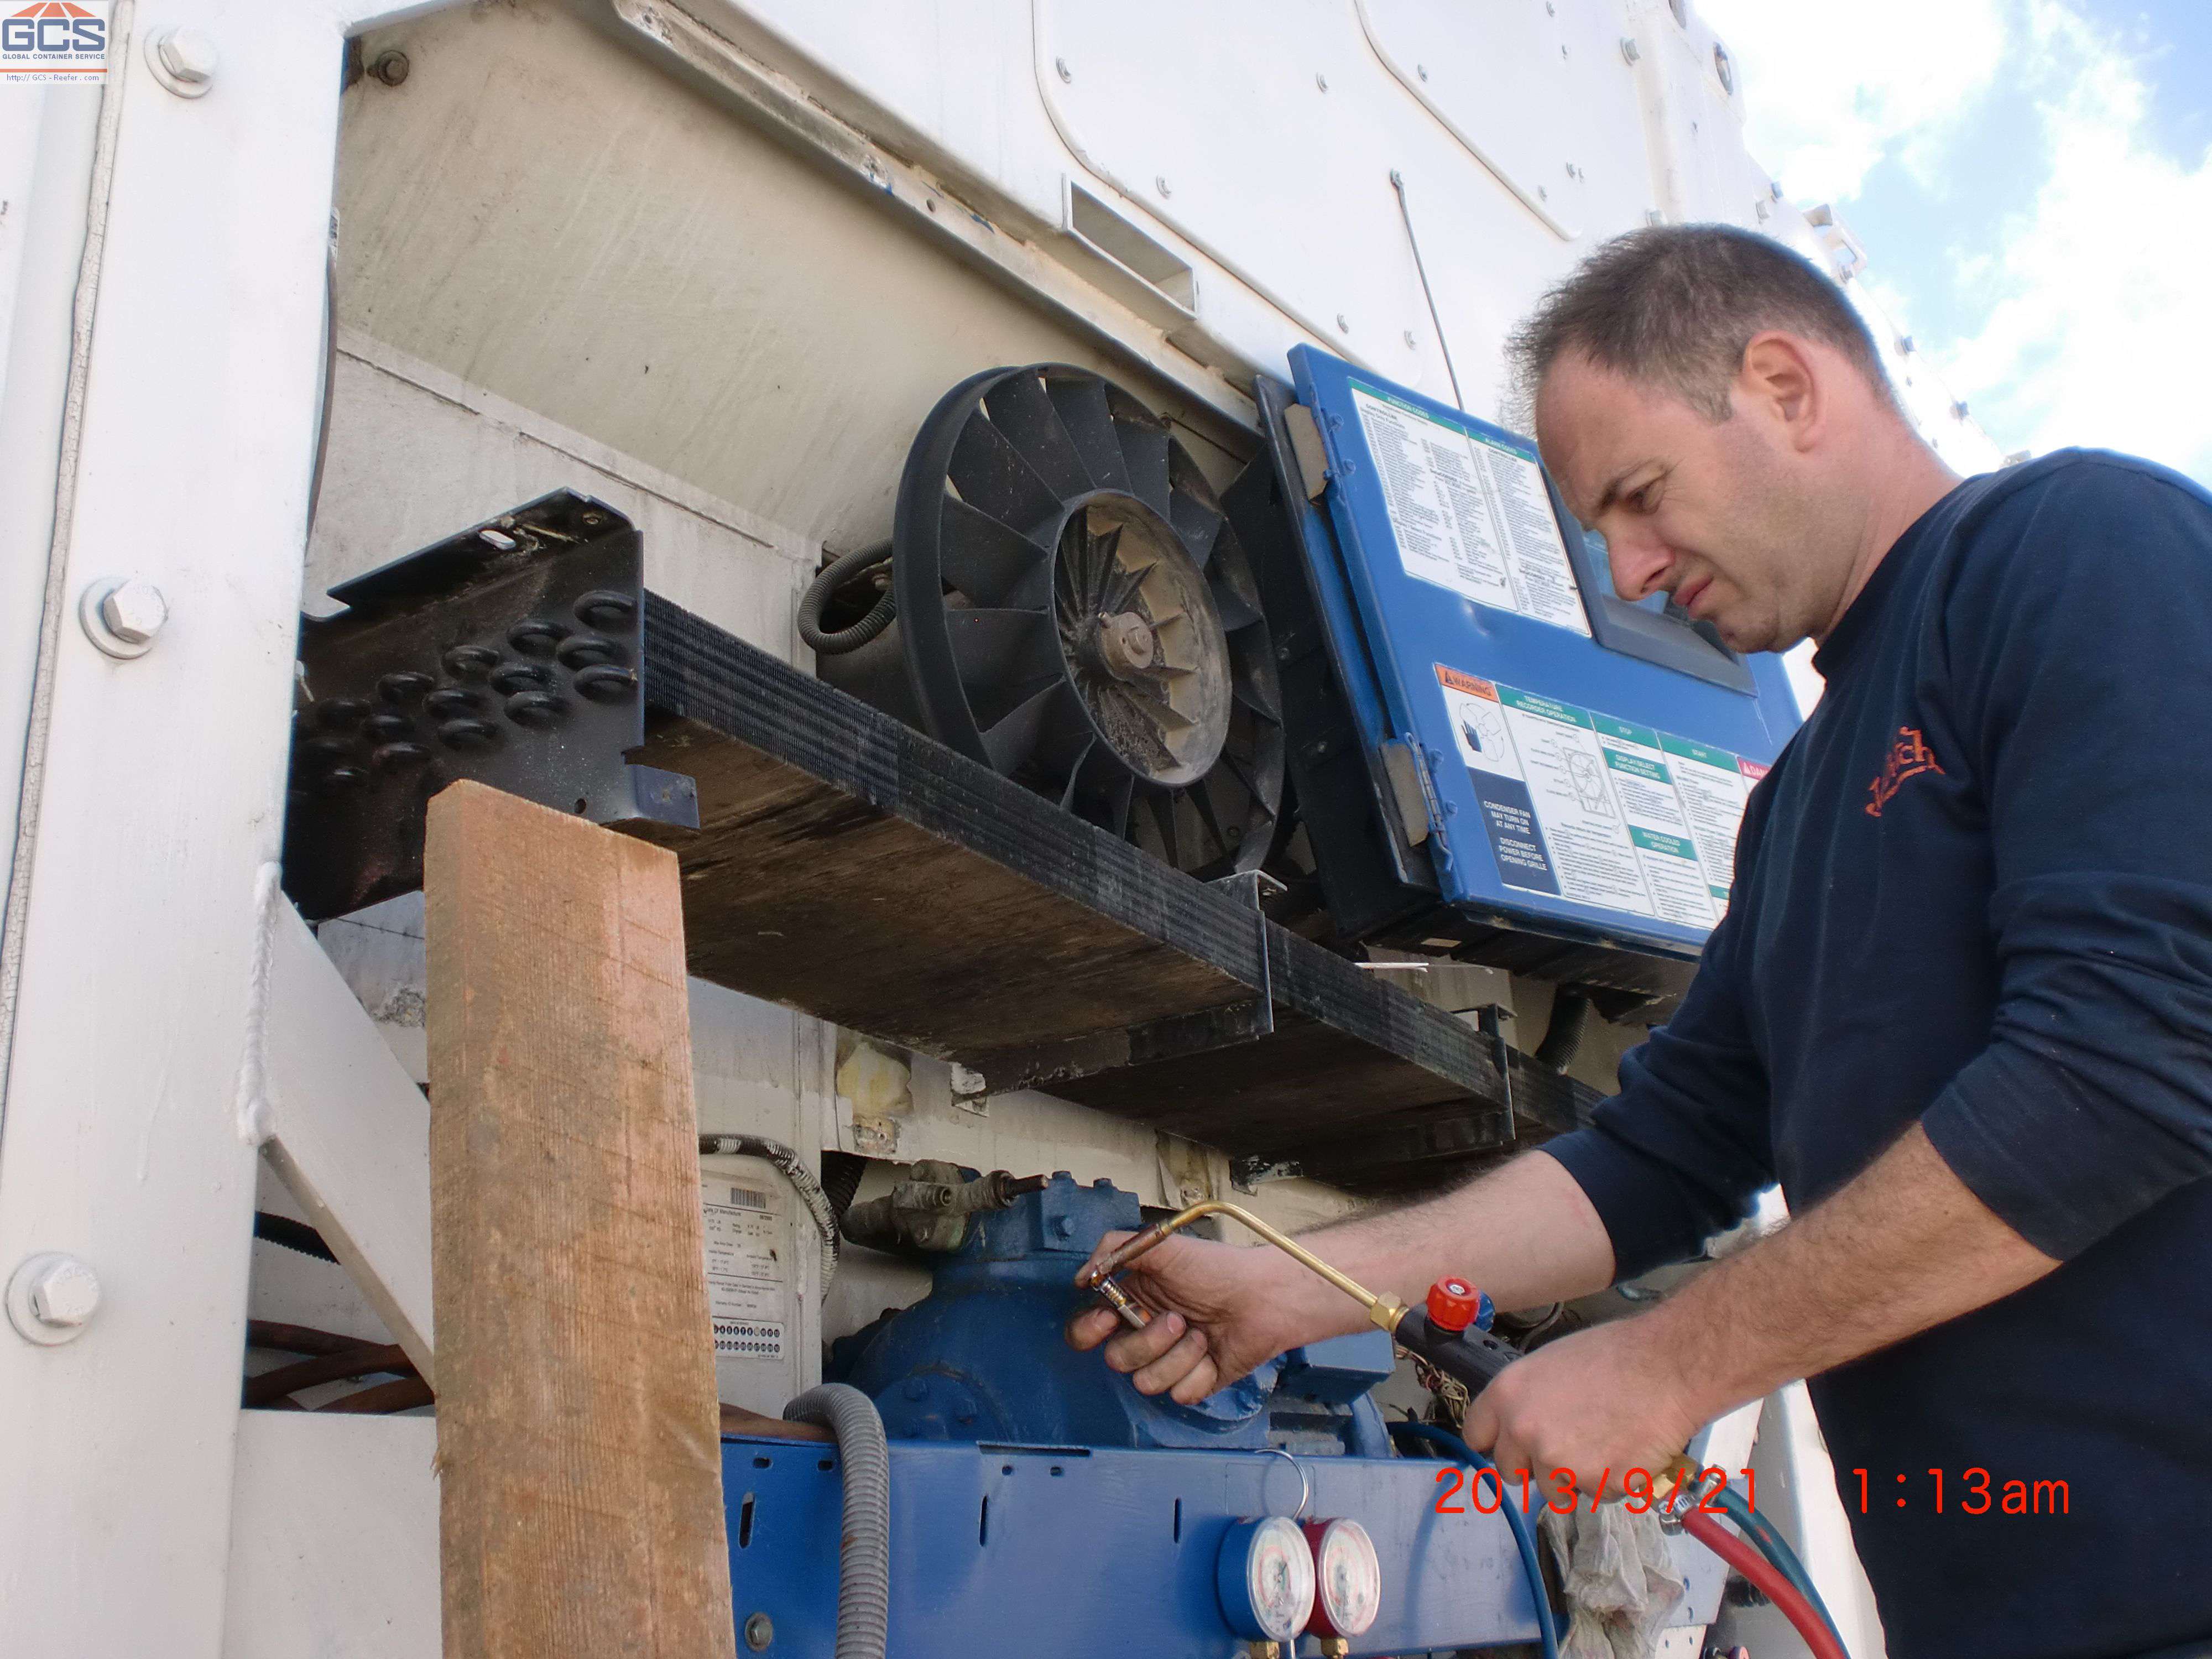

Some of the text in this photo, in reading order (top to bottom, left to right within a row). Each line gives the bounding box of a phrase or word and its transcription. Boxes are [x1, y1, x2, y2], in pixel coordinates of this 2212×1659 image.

[1453, 677, 1491, 696] WARNING
[1516, 700, 1577, 722] RECORDER OPERATION
[1524, 695, 1563, 712] TEMPERATURE
[1619, 726, 1632, 735] STOP
[1692, 748, 1707, 758] START
[1615, 761, 1640, 773] FUNCTION
[1484, 800, 1531, 818] CONDENSER FAN
[1504, 813, 1520, 823] TURN
[1504, 822, 1516, 830] ANY
[1516, 825, 1531, 834] TIME
[1499, 837, 1536, 852] DISCONNECT
[1641, 831, 1681, 846] WATER COOLED
[1499, 844, 1544, 862] POWER BEFORE
[1651, 841, 1680, 853] OPERATION
[1501, 854, 1548, 870] OPENING GRILLE
